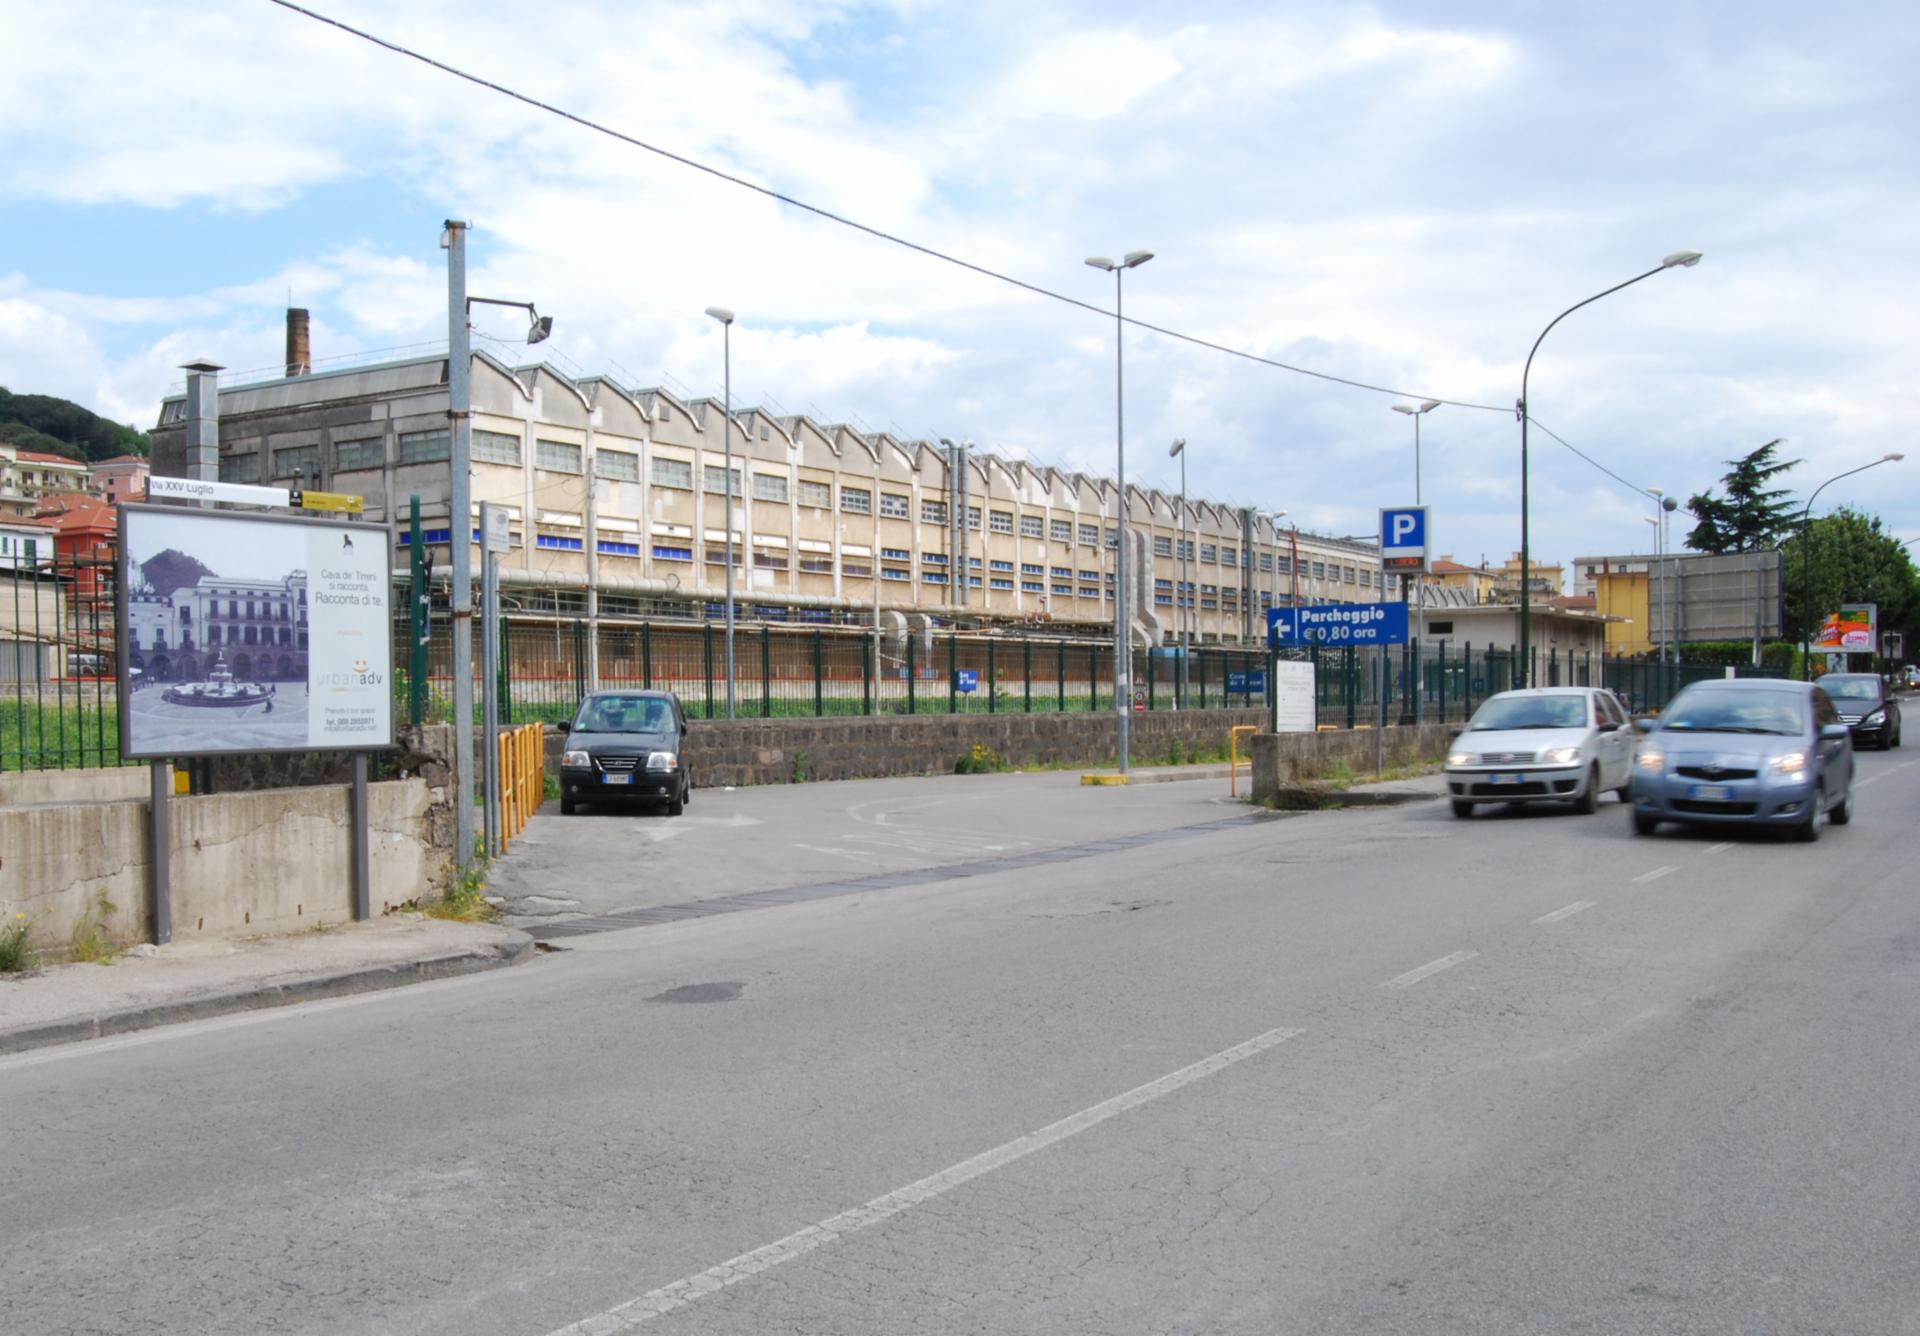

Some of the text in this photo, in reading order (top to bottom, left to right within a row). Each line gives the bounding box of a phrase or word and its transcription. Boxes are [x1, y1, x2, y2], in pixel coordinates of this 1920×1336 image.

[151, 480, 214, 496] Via XXV Luglio
[1393, 514, 1416, 545] P
[321, 569, 341, 580] Cava
[315, 591, 360, 605] Racconta
[361, 594, 370, 606] di
[1301, 606, 1385, 624] Parcheggio
[1317, 626, 1349, 644] 0,80
[1353, 628, 1377, 639] ora
[316, 671, 383, 686] urbanadv
